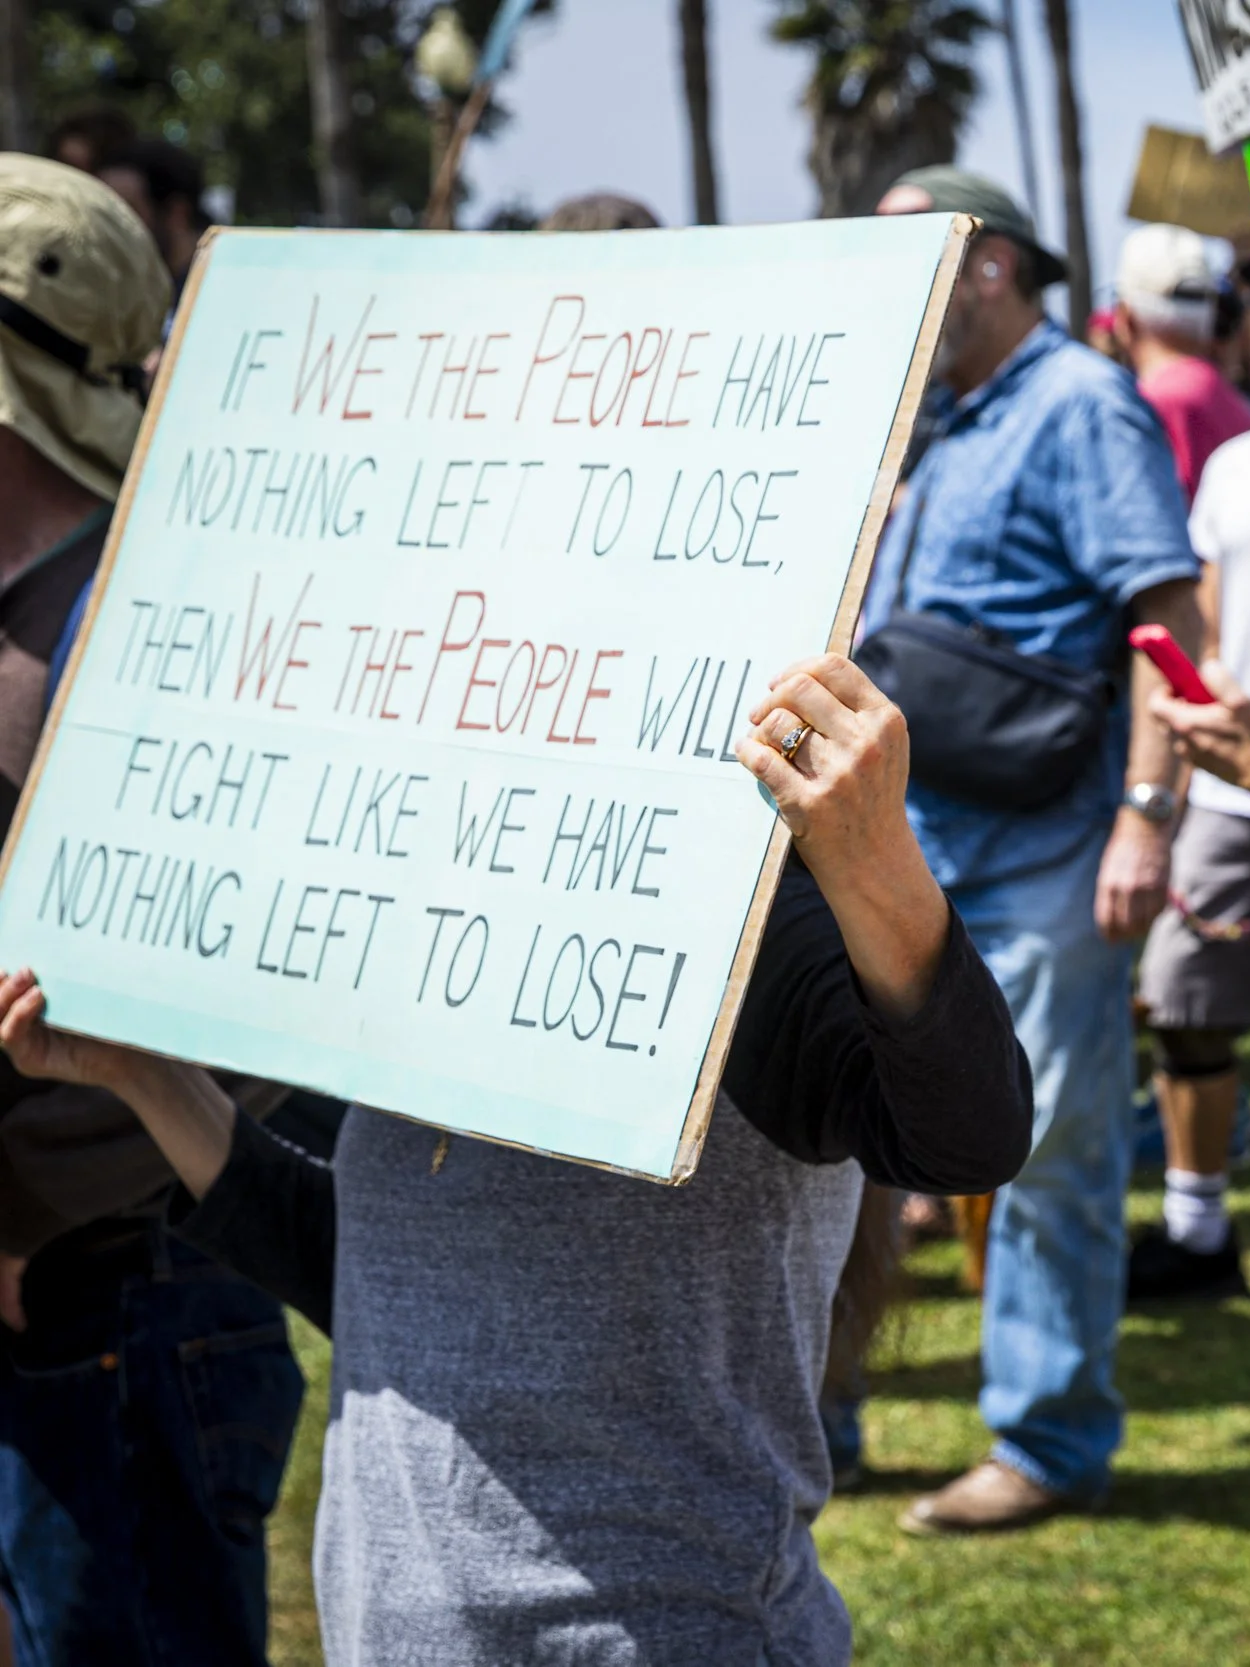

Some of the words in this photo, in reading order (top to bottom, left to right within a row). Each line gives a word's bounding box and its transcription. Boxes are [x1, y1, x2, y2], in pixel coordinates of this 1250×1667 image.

[220, 329, 284, 412] IF
[291, 293, 397, 420] WE
[405, 332, 511, 420] THE
[515, 294, 711, 427] PEOPLE
[712, 331, 846, 431] HAVE
[166, 447, 378, 539] NOTHING
[397, 458, 544, 550] LEFT
[565, 463, 634, 556] TO
[653, 468, 799, 575] LOSE,
[115, 600, 234, 698] THEN
[234, 572, 322, 710] WE
[334, 625, 424, 719] THE
[417, 590, 624, 745] PEOPLE
[637, 655, 752, 762] WILL
[114, 736, 291, 830] FIGHT
[304, 763, 430, 857] LIKE
[453, 780, 536, 874] WE
[541, 794, 679, 898] HAVE
[37, 836, 242, 959] NOTHING
[256, 878, 395, 990] LEFT
[416, 906, 489, 1008] TO
[509, 923, 687, 1056] LOSE!
